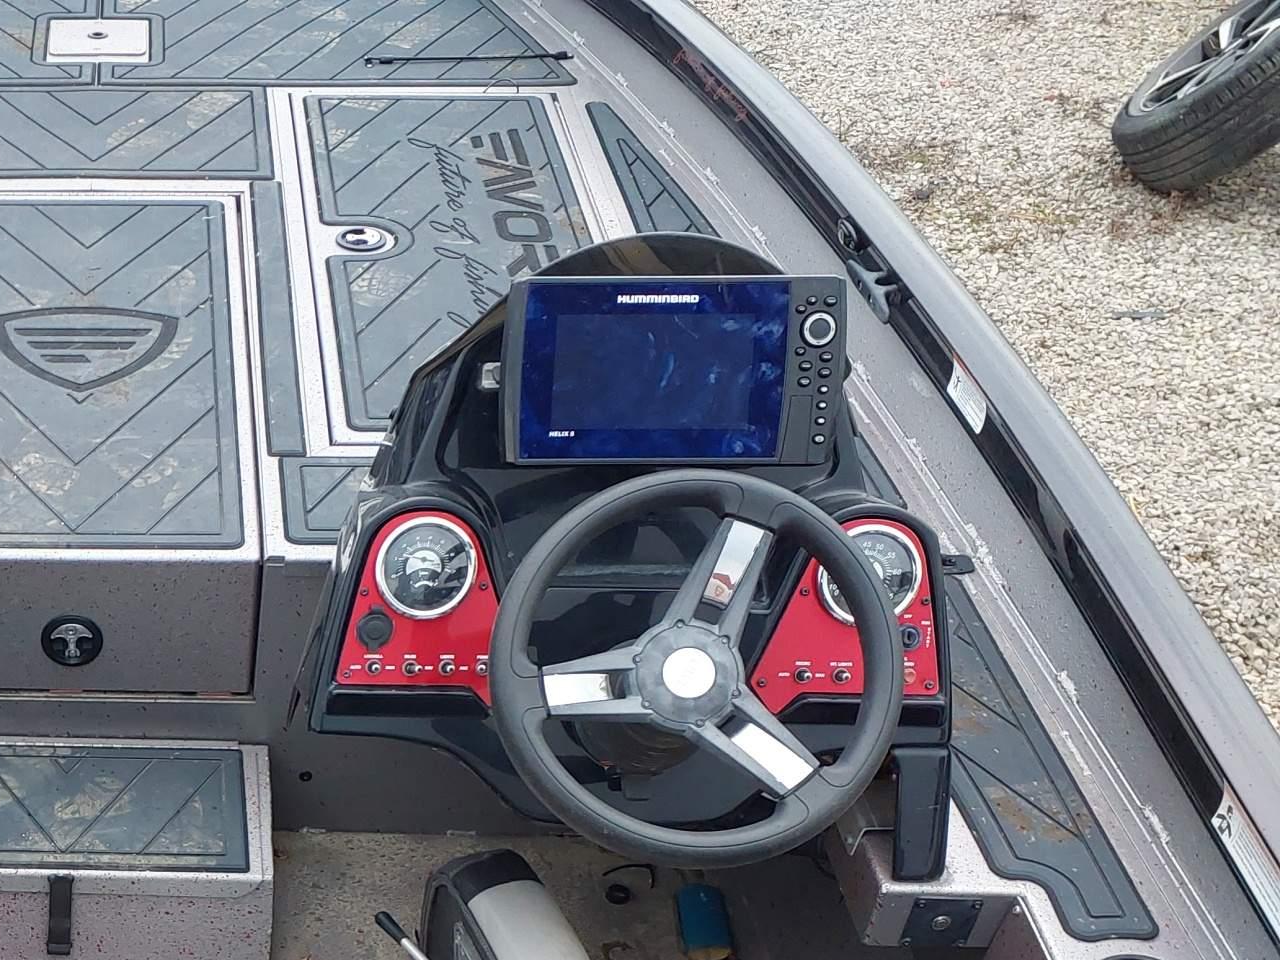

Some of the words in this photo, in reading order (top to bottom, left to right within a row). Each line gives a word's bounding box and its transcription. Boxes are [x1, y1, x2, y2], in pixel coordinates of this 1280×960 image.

[407, 138, 472, 212] future
[470, 128, 560, 277] FAVOR
[429, 217, 480, 245] of
[617, 294, 700, 304] HUMMINBIRD
